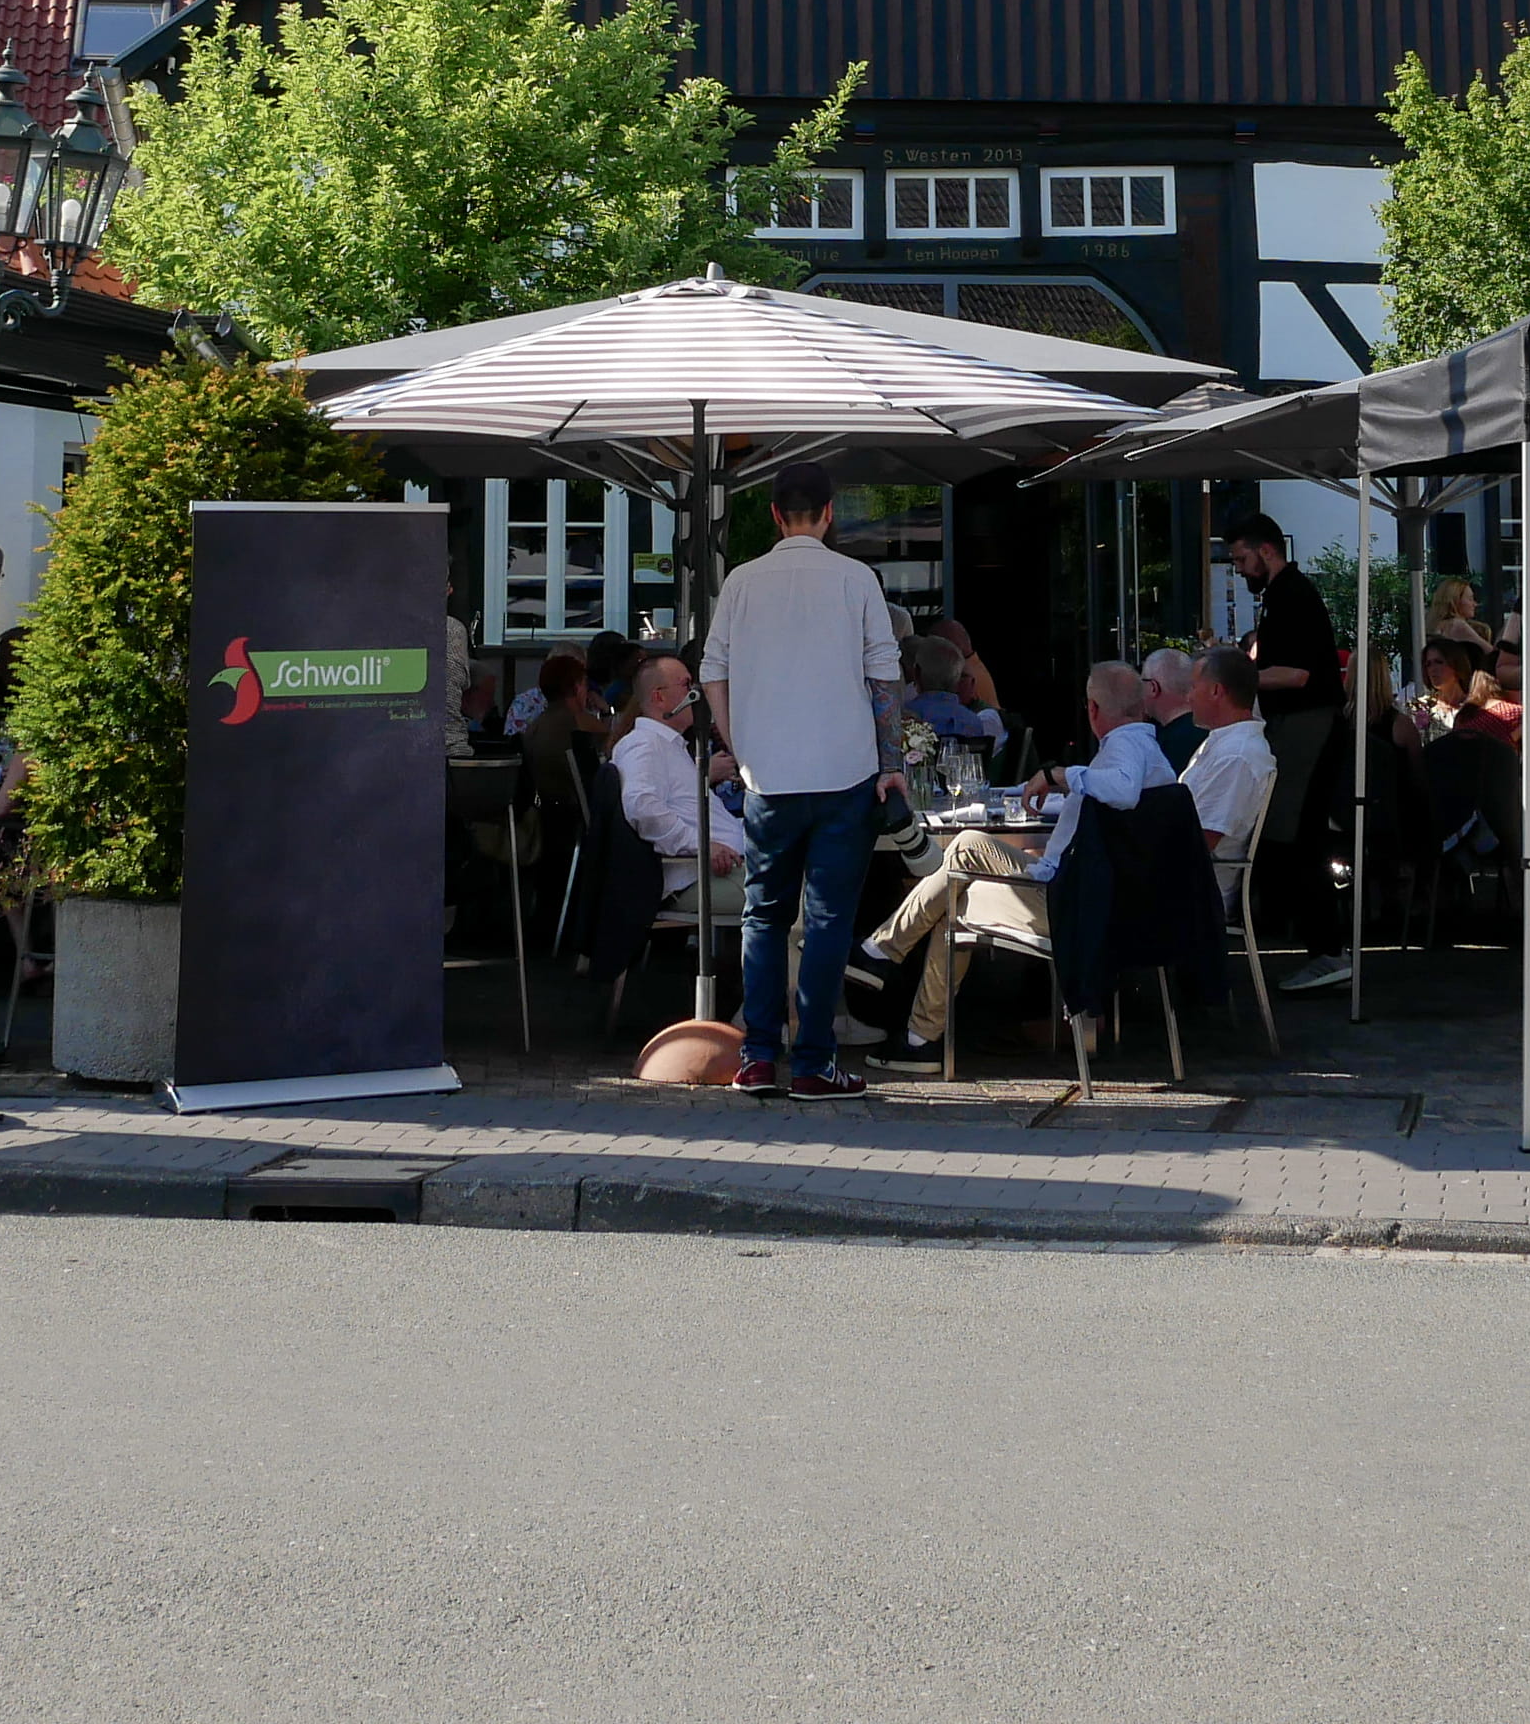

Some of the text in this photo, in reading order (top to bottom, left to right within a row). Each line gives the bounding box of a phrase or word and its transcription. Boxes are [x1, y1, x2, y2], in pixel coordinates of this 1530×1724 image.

[905, 148, 972, 164] Westen
[982, 148, 1023, 163] 2013
[780, 245, 840, 262] amilie
[906, 246, 935, 262] ten
